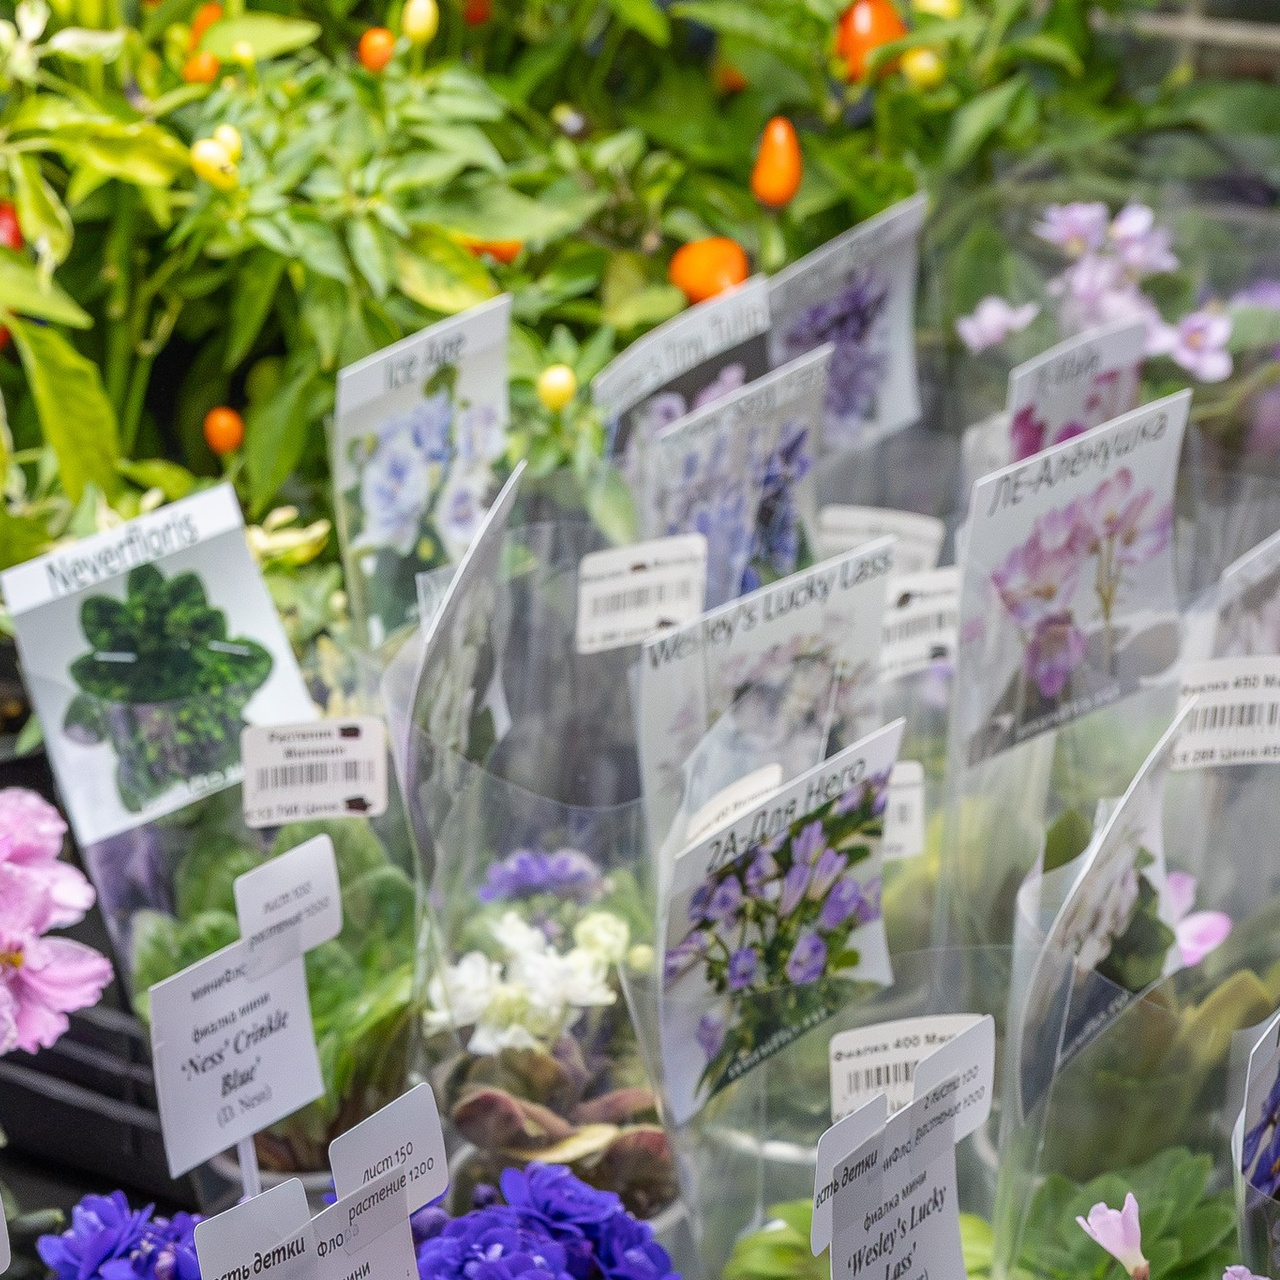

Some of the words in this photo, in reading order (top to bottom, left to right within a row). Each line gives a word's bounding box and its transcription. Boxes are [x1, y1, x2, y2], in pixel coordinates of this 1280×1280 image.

[762, 573, 836, 625] Lucky
[838, 551, 894, 591] Lass
[894, 1034, 921, 1051] 400
[362, 1155, 393, 1186] лист
[394, 1141, 415, 1168] 150
[840, 1148, 879, 1190] детки
[348, 1176, 408, 1227] растение
[408, 1157, 436, 1185] 1200
[863, 1192, 901, 1232] фиалка
[901, 1170, 928, 1201] мини
[908, 1186, 948, 1231] Lucky
[252, 1235, 307, 1277] детки
